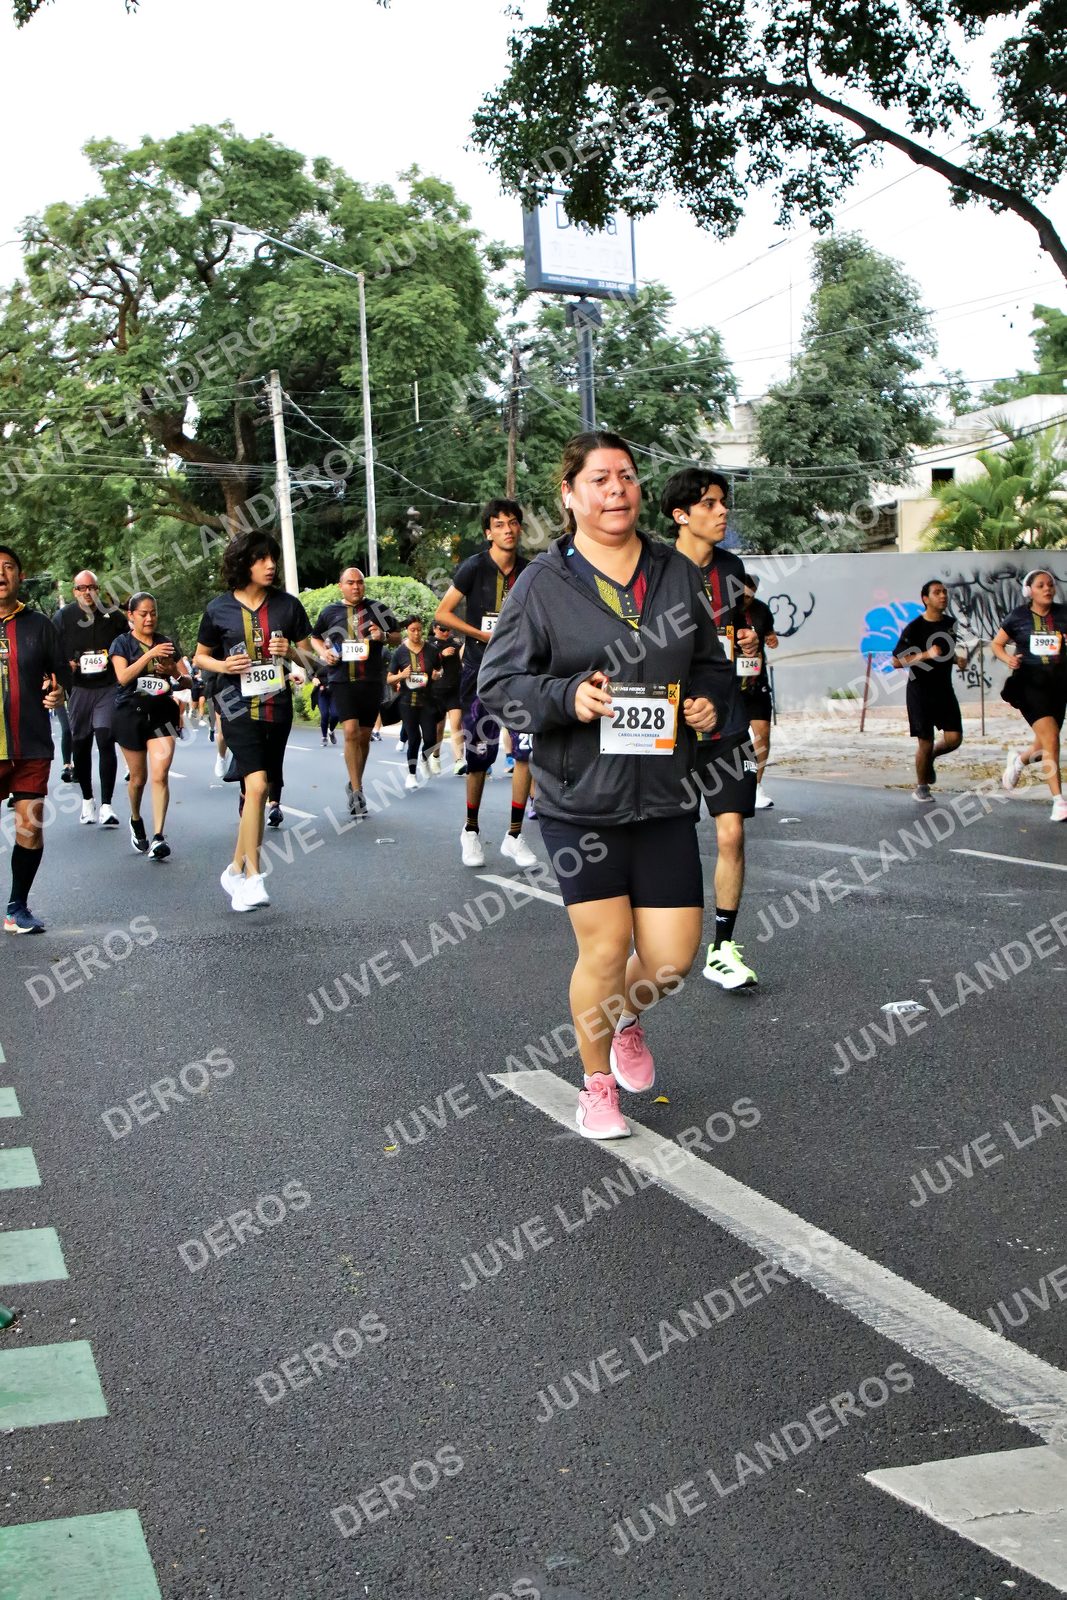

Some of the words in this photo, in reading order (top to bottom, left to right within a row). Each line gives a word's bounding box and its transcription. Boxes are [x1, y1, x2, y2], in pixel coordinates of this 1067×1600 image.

[345, 645, 364, 653] 2106
[84, 657, 103, 666] 7465
[741, 660, 759, 668] 1246
[245, 669, 275, 683] 3880
[141, 680, 164, 690] 3879
[612, 706, 665, 730] 2828
